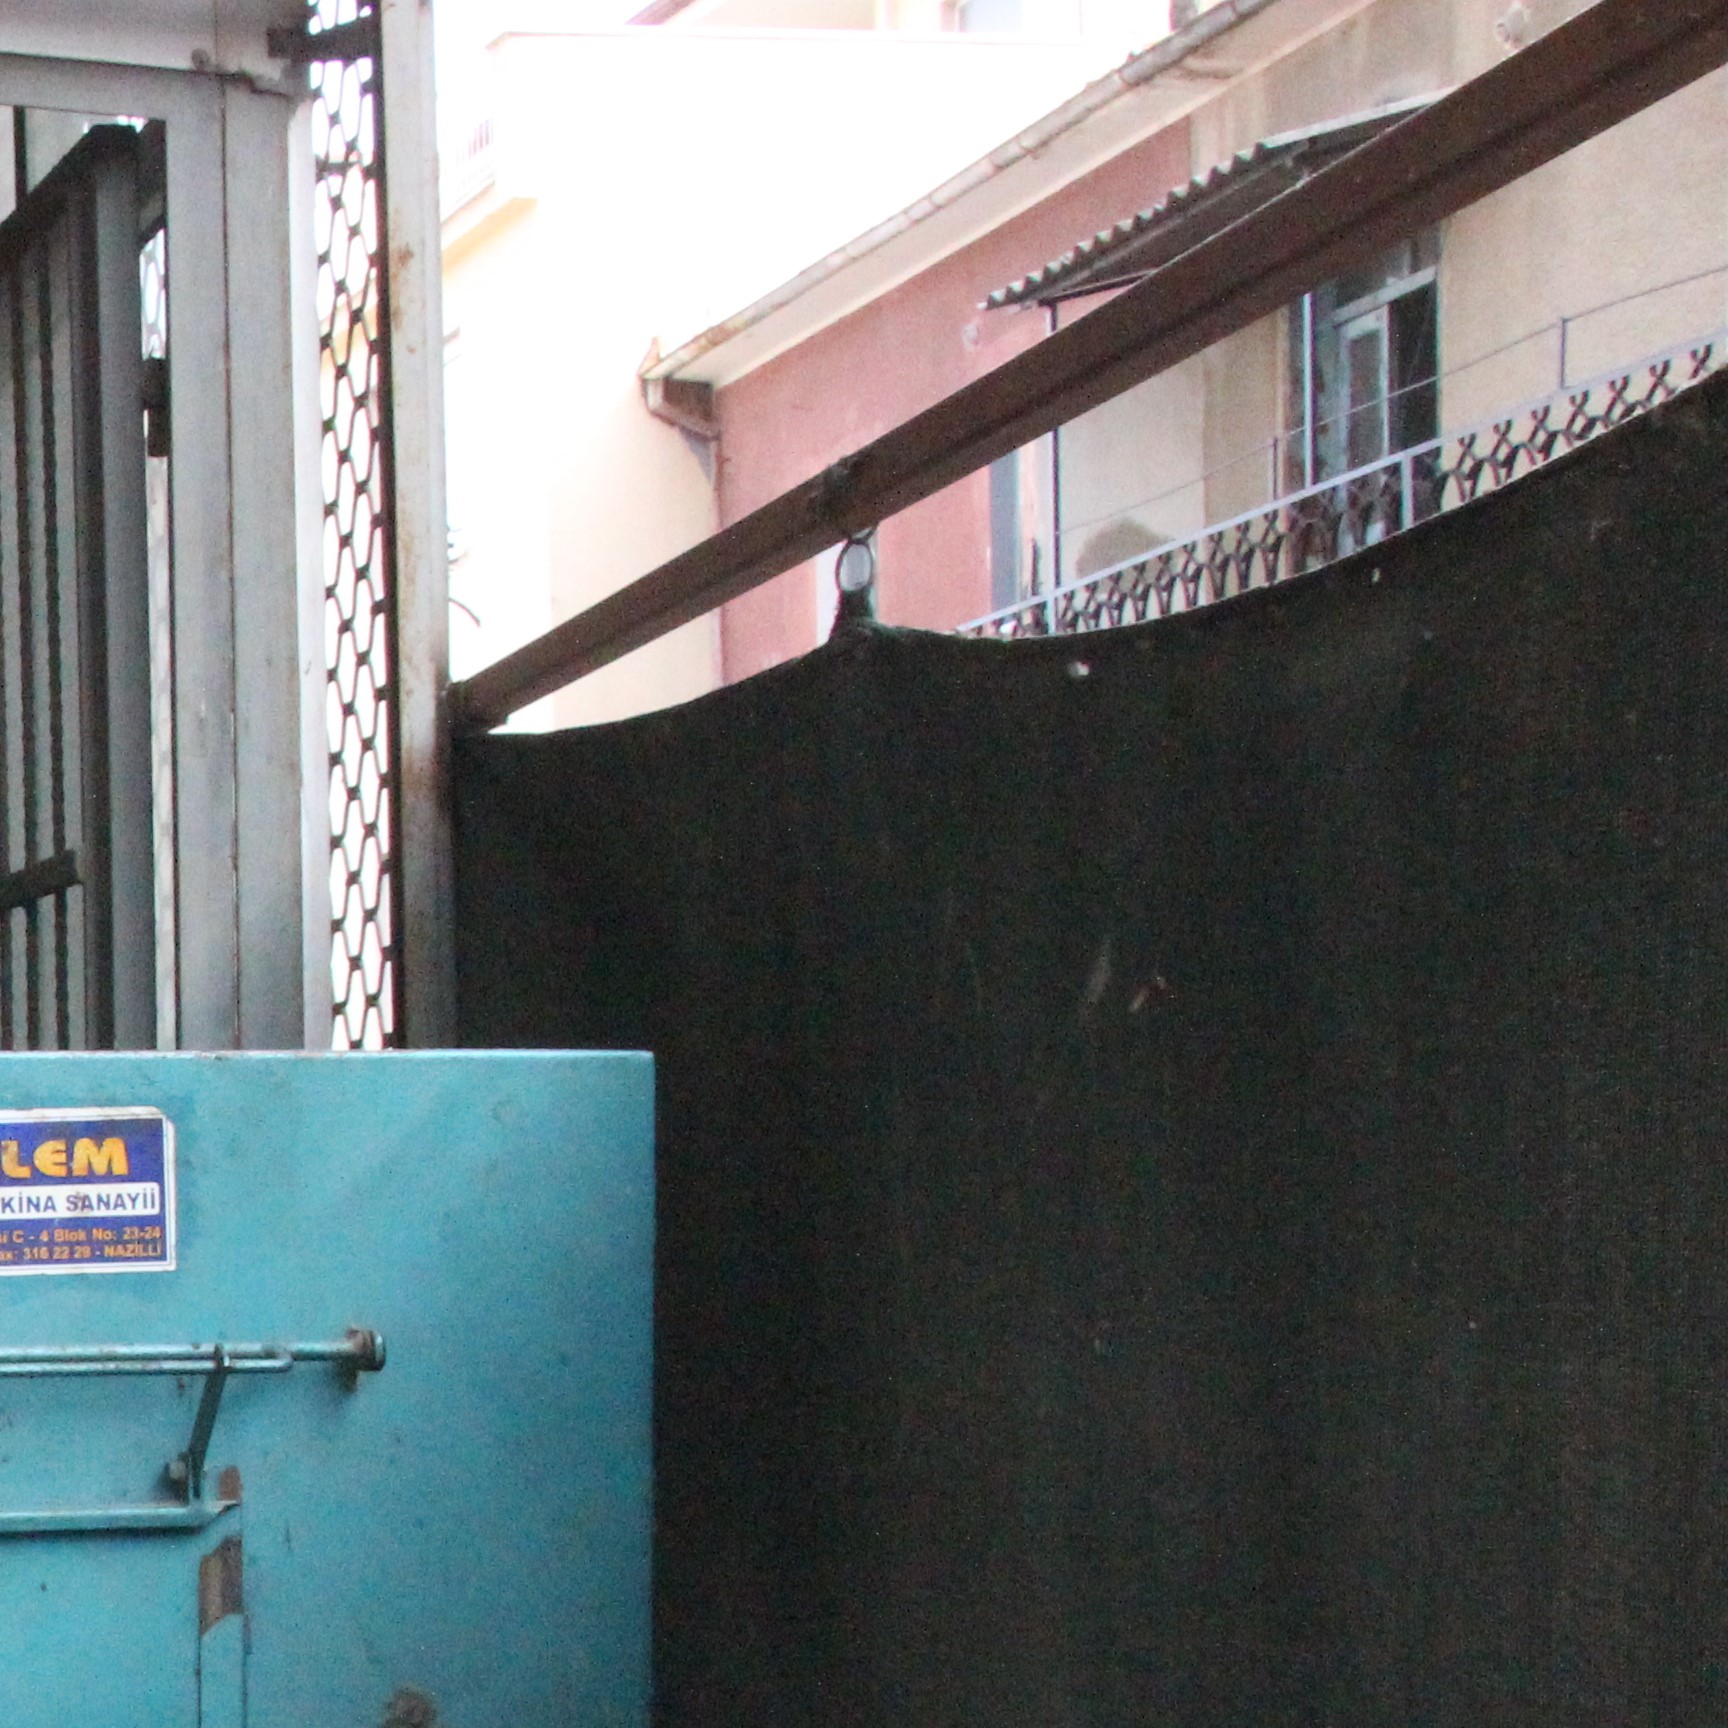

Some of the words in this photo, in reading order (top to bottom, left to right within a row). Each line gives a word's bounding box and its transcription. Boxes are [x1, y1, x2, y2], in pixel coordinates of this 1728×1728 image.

[65, 1188, 156, 1212] SANAYİİ
[13, 1230, 24, 1243] C
[53, 1228, 87, 1242] Blok
[92, 1228, 117, 1241] No:
[53, 1246, 70, 1259] 22
